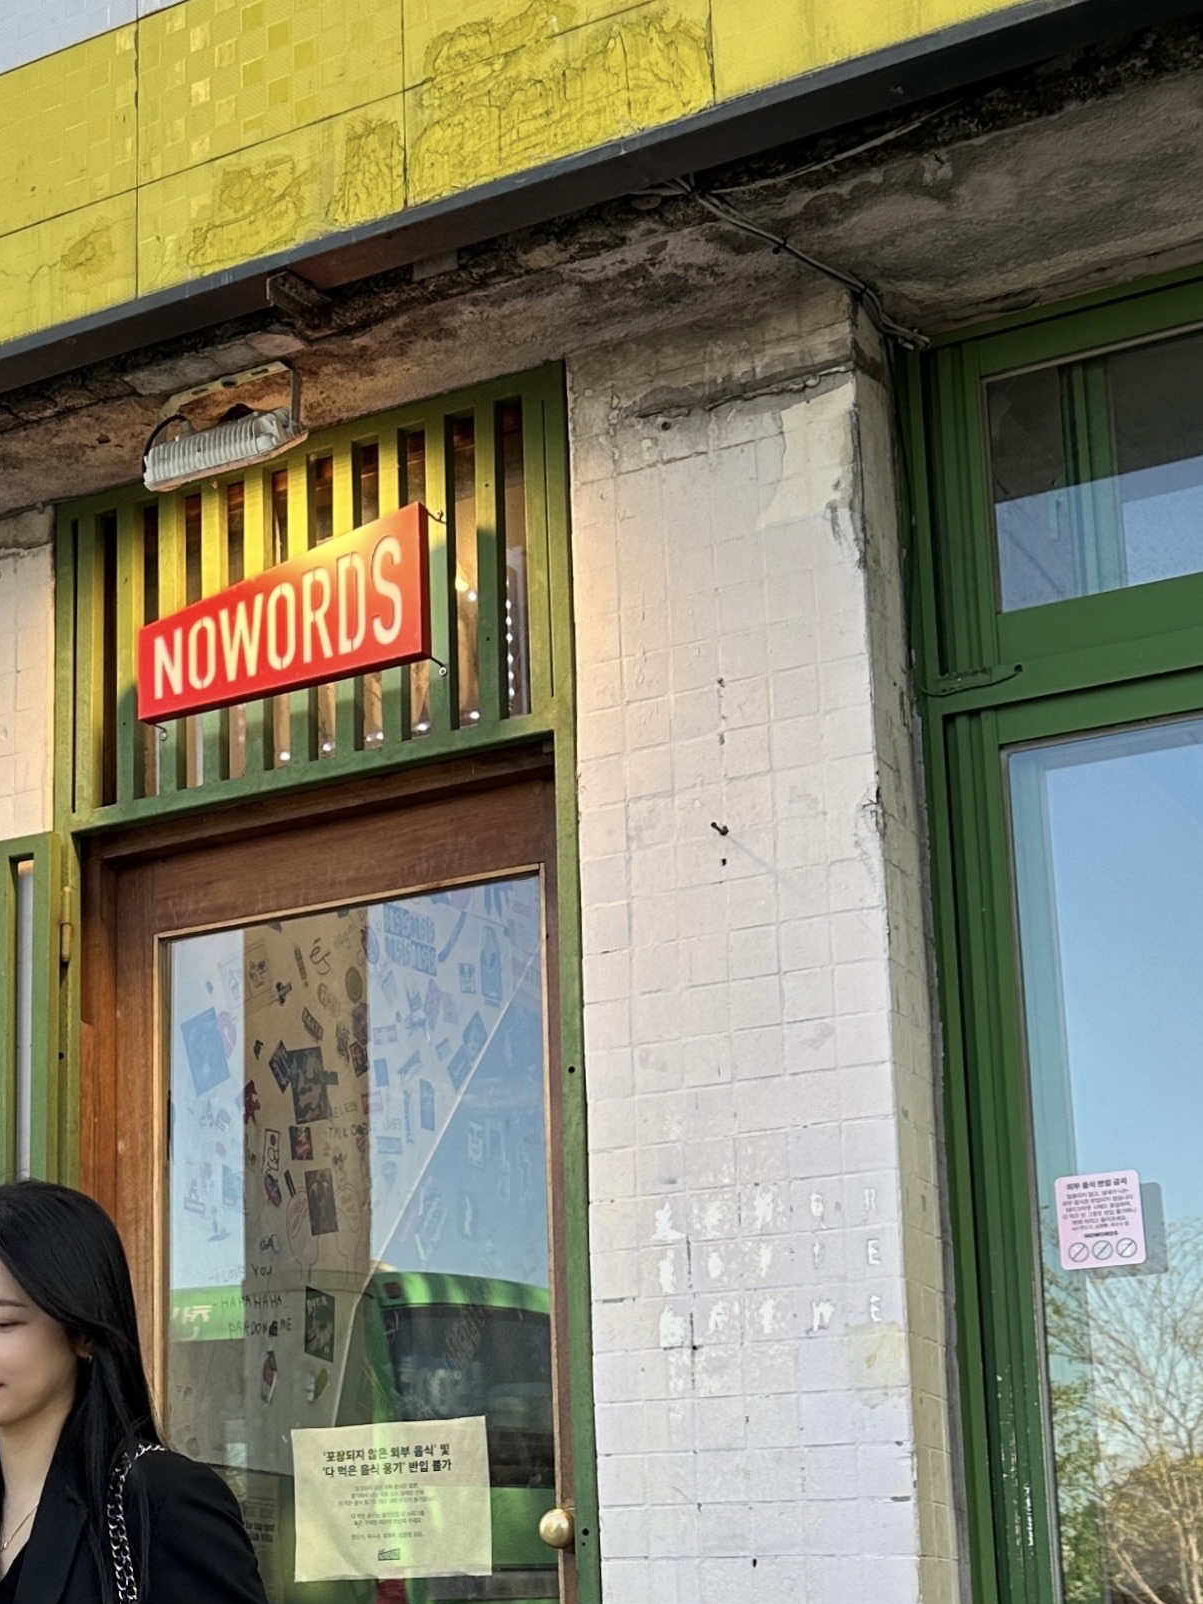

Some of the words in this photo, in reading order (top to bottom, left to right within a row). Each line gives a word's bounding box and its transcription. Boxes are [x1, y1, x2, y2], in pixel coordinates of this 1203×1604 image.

[153, 534, 403, 700] NOWORDS
[251, 1263, 272, 1279] YOU
[368, 1447, 388, 1460] 않은
[390, 1445, 410, 1459] 외부
[440, 1443, 450, 1456] 및
[338, 1464, 357, 1477] 먹은
[360, 1463, 379, 1476] 음식
[409, 1460, 429, 1473] 반입
